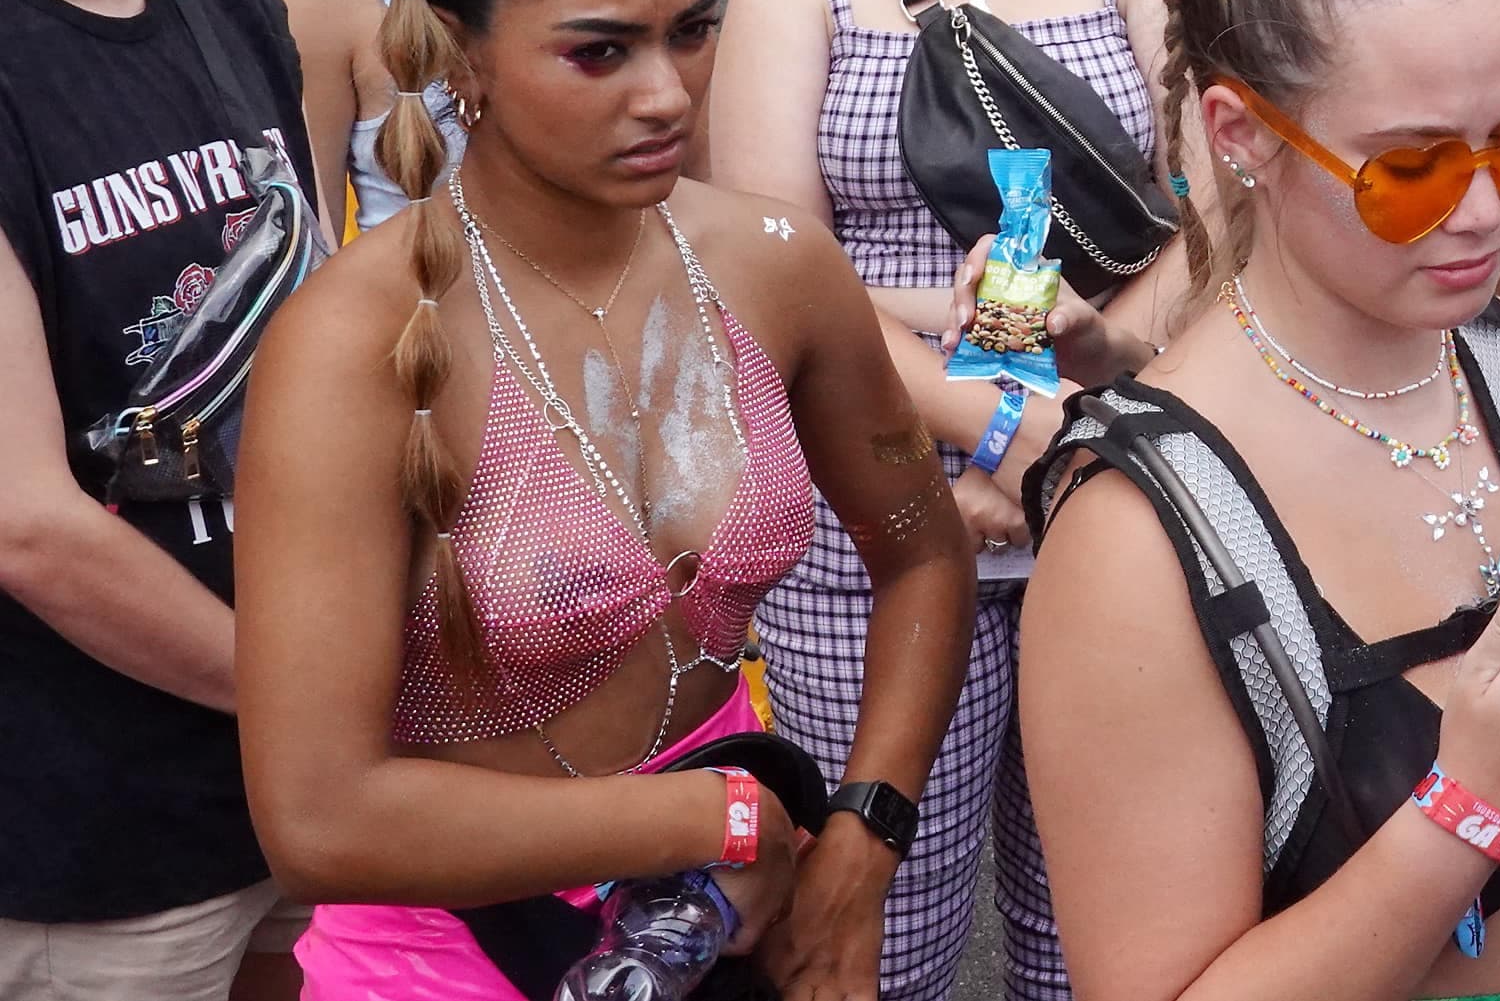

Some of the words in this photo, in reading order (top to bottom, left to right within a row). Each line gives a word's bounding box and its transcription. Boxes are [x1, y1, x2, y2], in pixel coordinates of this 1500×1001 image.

[52, 159, 181, 256] GUNS
[728, 801, 751, 837] GA
[1455, 814, 1500, 849] GA
